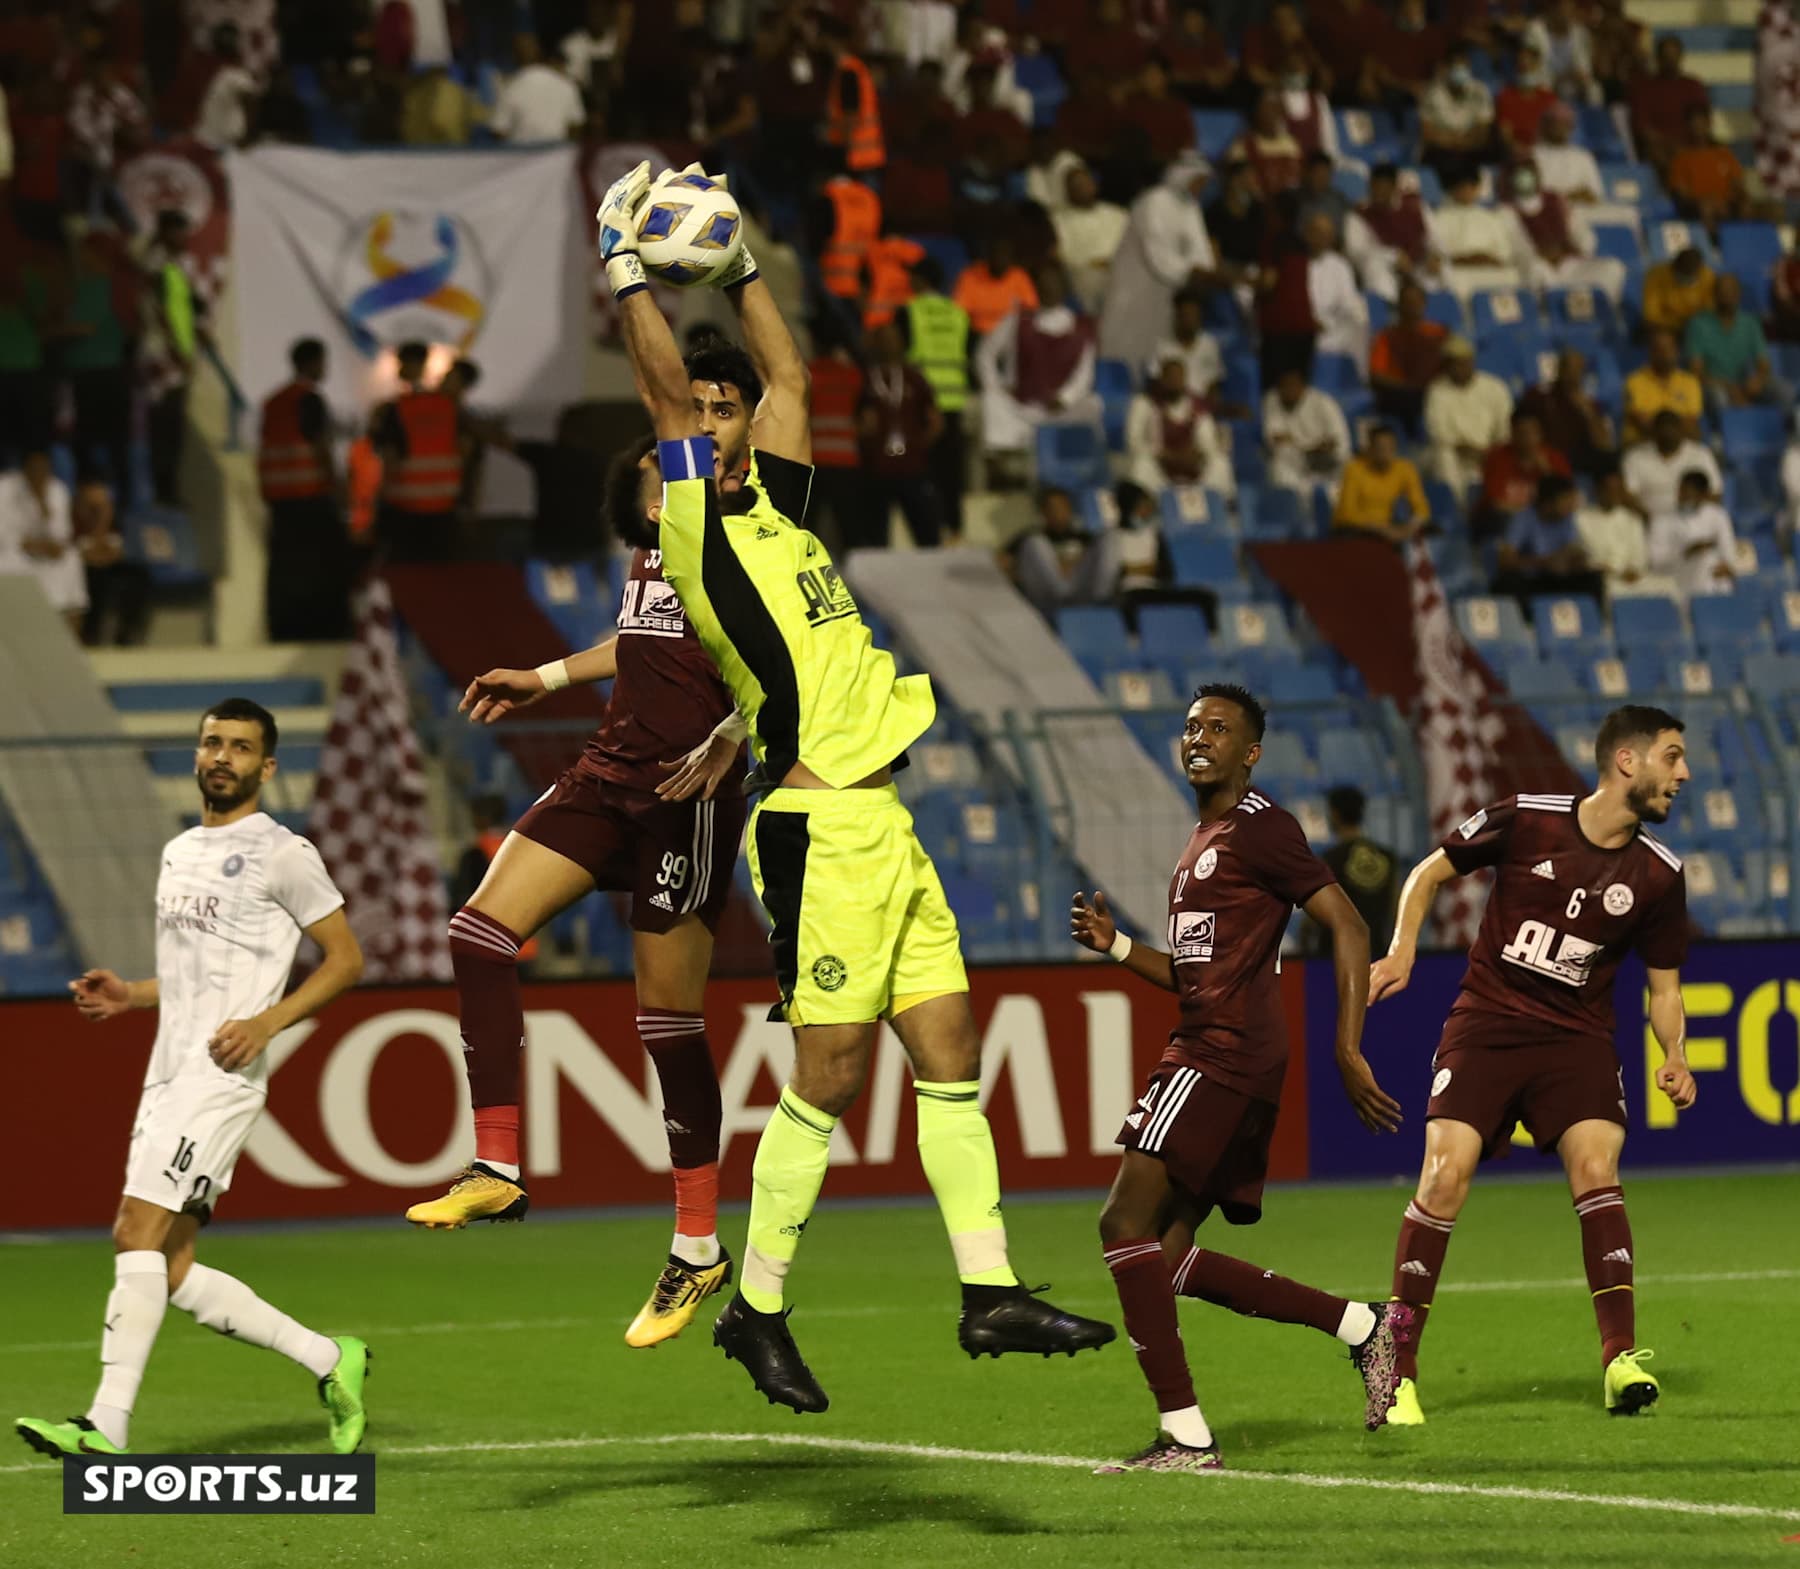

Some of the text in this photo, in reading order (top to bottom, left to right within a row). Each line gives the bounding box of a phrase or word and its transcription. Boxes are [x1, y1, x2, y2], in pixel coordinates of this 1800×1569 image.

[656, 851, 689, 889] 99
[1565, 887, 1587, 919] 6
[1502, 919, 1557, 971] AL
[171, 1136, 196, 1173] 16
